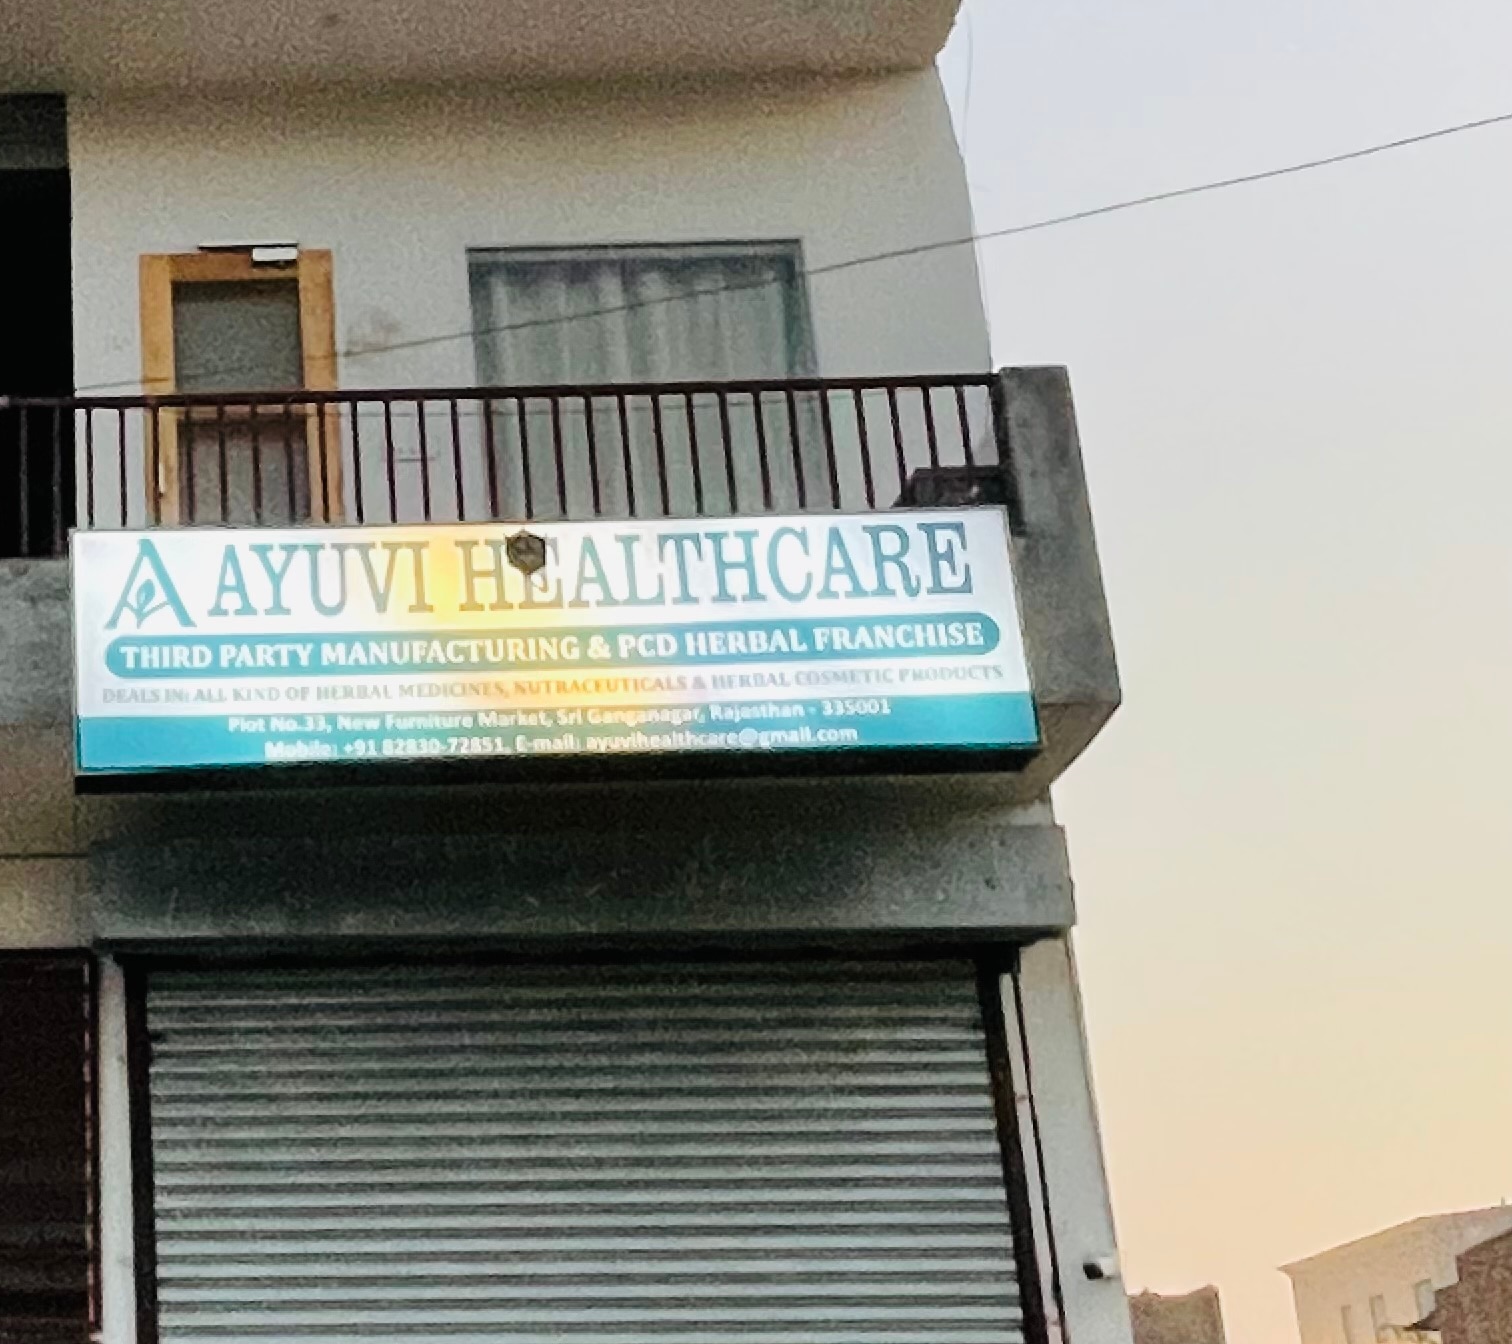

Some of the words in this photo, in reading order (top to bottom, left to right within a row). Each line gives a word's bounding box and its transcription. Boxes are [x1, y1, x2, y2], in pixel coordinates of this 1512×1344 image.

[207, 541, 434, 618] AYUVI
[454, 521, 974, 613] HEALTHCARE
[119, 644, 212, 669] THIRD
[219, 643, 314, 668] PARTY
[321, 636, 579, 666] MANUFACTURING
[587, 635, 612, 660] &
[617, 632, 678, 660] PCD
[685, 628, 808, 656] HERBAL
[812, 622, 984, 651] FRANCHISE
[103, 688, 159, 704] DEALS
[194, 687, 227, 703] ALL
[233, 686, 280, 702] KIND
[285, 686, 309, 701] OF
[317, 684, 393, 701] HERBAL
[399, 681, 509, 699] MEDICINES,
[514, 675, 687, 697] NUTRACEUTICALS
[691, 675, 707, 690] &
[712, 672, 790, 689] HERBAL
[795, 668, 893, 685] COSMETIC
[899, 665, 1003, 682] PRODUCTS
[229, 716, 265, 732] Plot
[337, 714, 380, 731] New
[385, 713, 474, 730] Furniture
[478, 710, 552, 729] Market,
[557, 708, 583, 727] Sri
[709, 703, 806, 723] Rajasthan
[821, 698, 892, 716] 335001
[343, 739, 377, 756] +91
